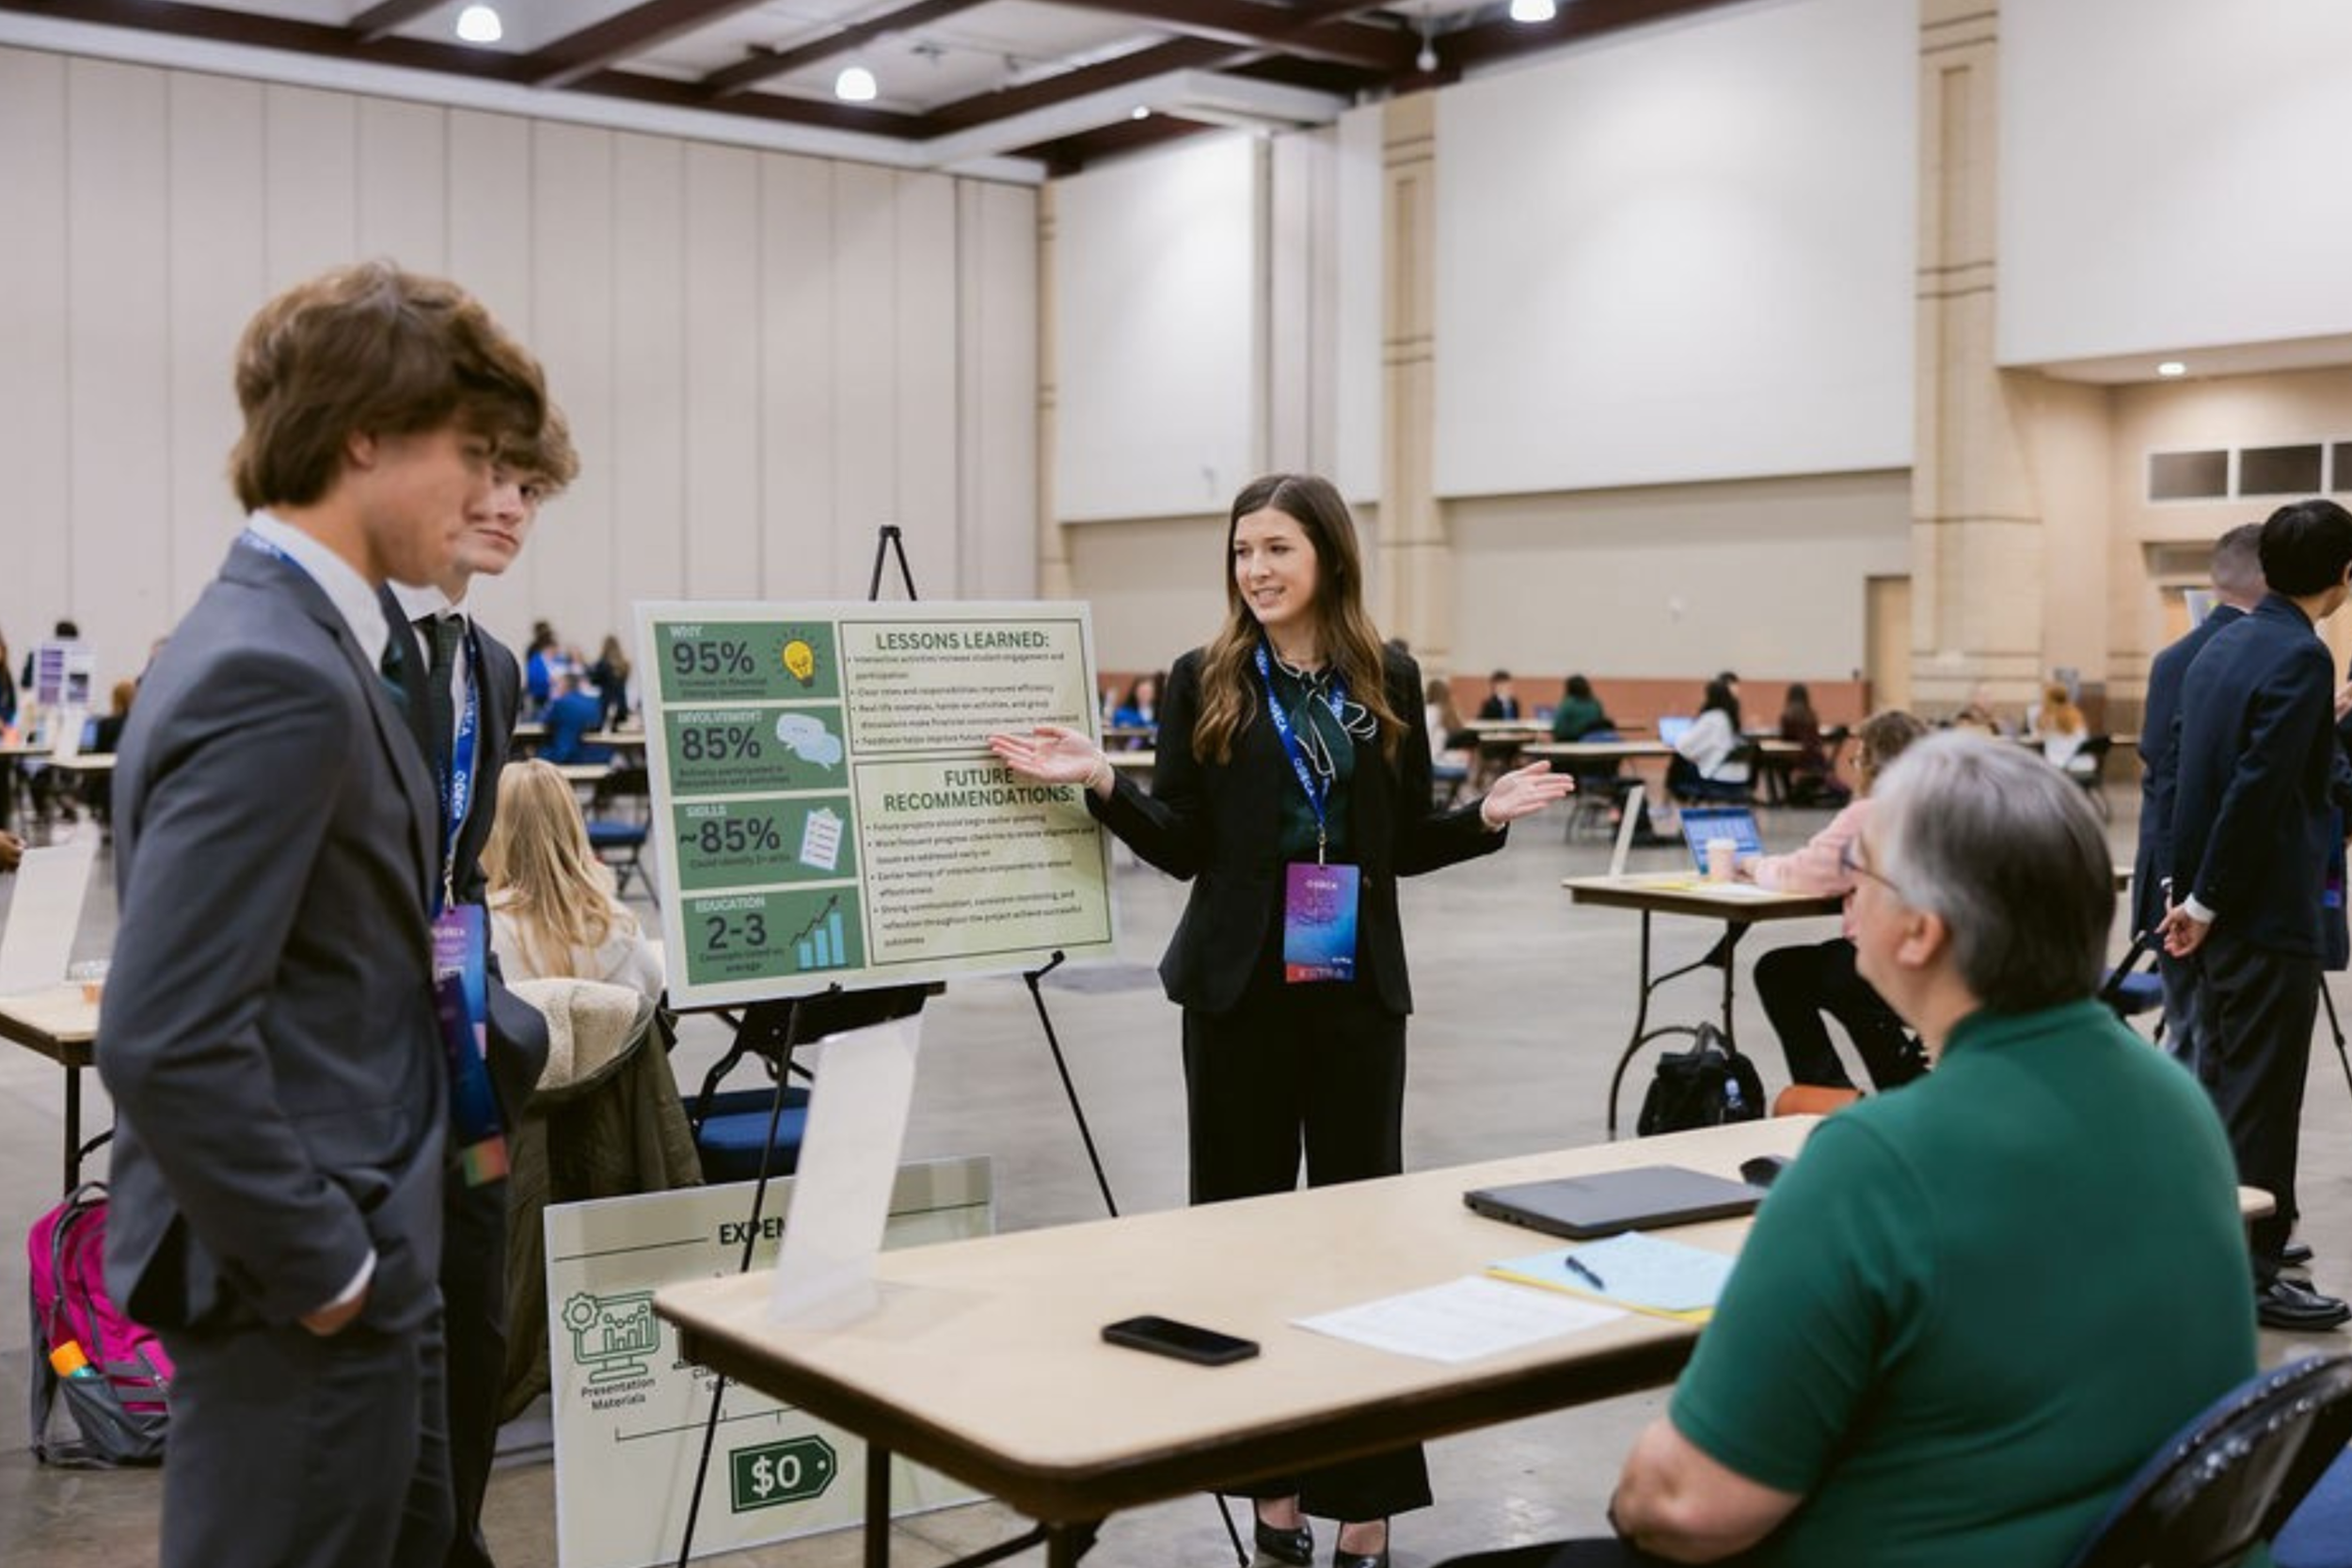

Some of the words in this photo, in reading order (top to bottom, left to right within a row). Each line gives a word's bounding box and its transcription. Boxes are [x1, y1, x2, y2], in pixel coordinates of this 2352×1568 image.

[875, 632, 961, 650] LESSONS
[963, 630, 1049, 648] LEARNED:
[672, 641, 755, 675] 95%
[1051, 651, 1064, 660] and
[857, 688, 879, 697] Clear
[902, 687, 917, 696] and
[1017, 683, 1054, 693] efficiency
[1011, 699, 1026, 708] and
[1027, 700, 1049, 710] group
[909, 719, 930, 727] make
[681, 726, 761, 761] 85%
[959, 733, 983, 741] future
[944, 768, 1014, 787] FUTURE
[882, 785, 1075, 813] RECOMMENDATIONS:
[902, 820, 935, 832] projects
[964, 816, 986, 827] begin
[679, 816, 781, 854] ~85%
[934, 834, 968, 846] progress
[906, 869, 934, 880] testing
[695, 895, 766, 913] EDUCATION
[881, 903, 909, 915] Strong
[1061, 889, 1075, 898] and
[969, 912, 983, 922] the
[706, 912, 767, 950] 2-3
[580, 1376, 656, 1399] Presentation
[591, 1392, 646, 1412] Materials
[751, 1454, 802, 1499] $0
